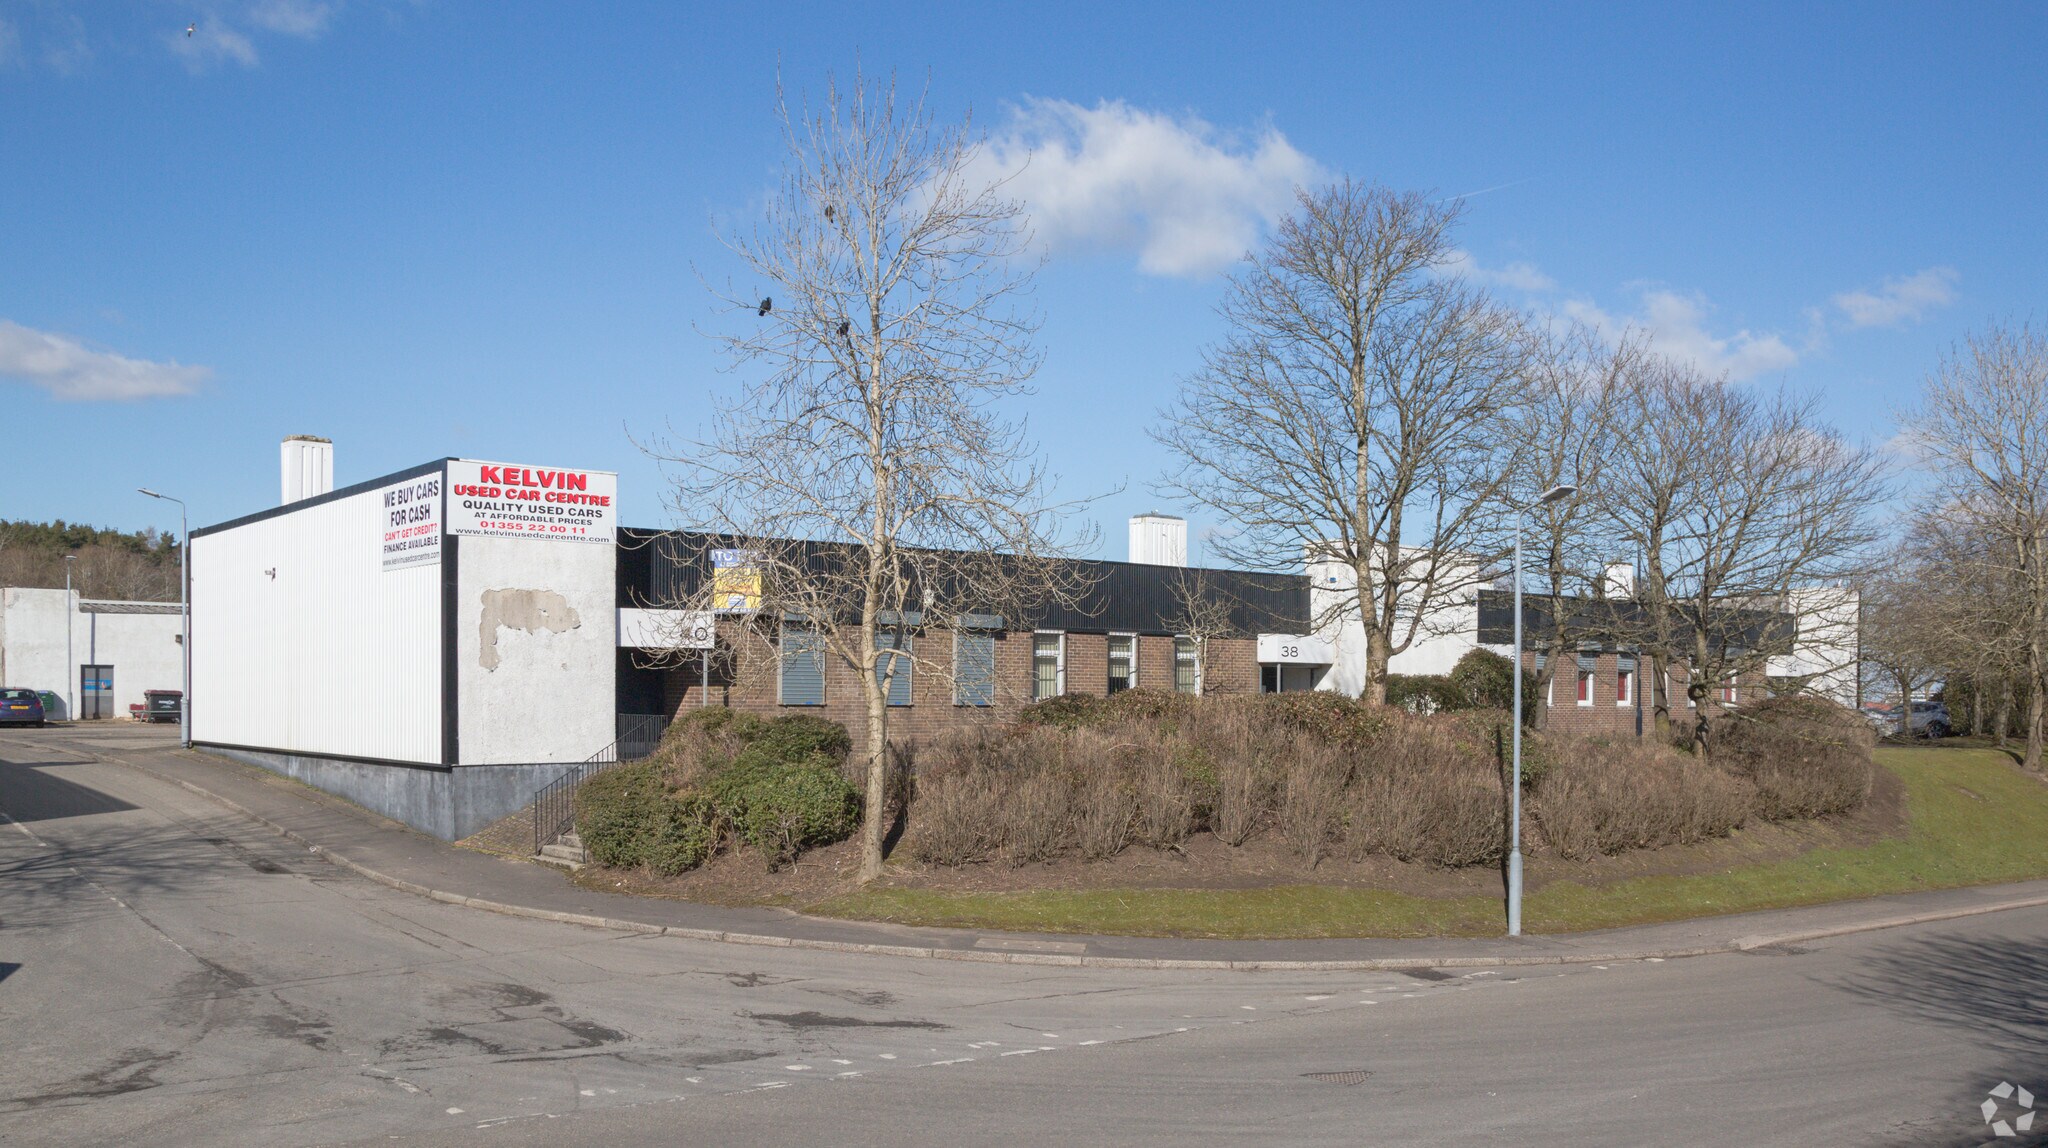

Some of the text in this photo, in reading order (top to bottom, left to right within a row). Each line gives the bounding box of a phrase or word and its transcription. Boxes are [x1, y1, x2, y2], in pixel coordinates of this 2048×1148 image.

[480, 466, 587, 491] KELVIN
[384, 480, 438, 508] WE BUY CARS
[454, 484, 610, 506] USED CAR CENTRE
[391, 504, 430, 527] FOR CASH
[463, 500, 603, 518] QUALITY USED CARS
[490, 513, 554, 523] AFFORDABLE
[385, 523, 437, 541] CAN'T GET CREDIT?
[480, 521, 523, 530] 01355
[456, 528, 609, 543] www.kelvinusedcarcentre.com
[384, 536, 438, 554] FINANCE AVAILABLE
[716, 552, 733, 561] TO
[1282, 646, 1298, 658] 38
